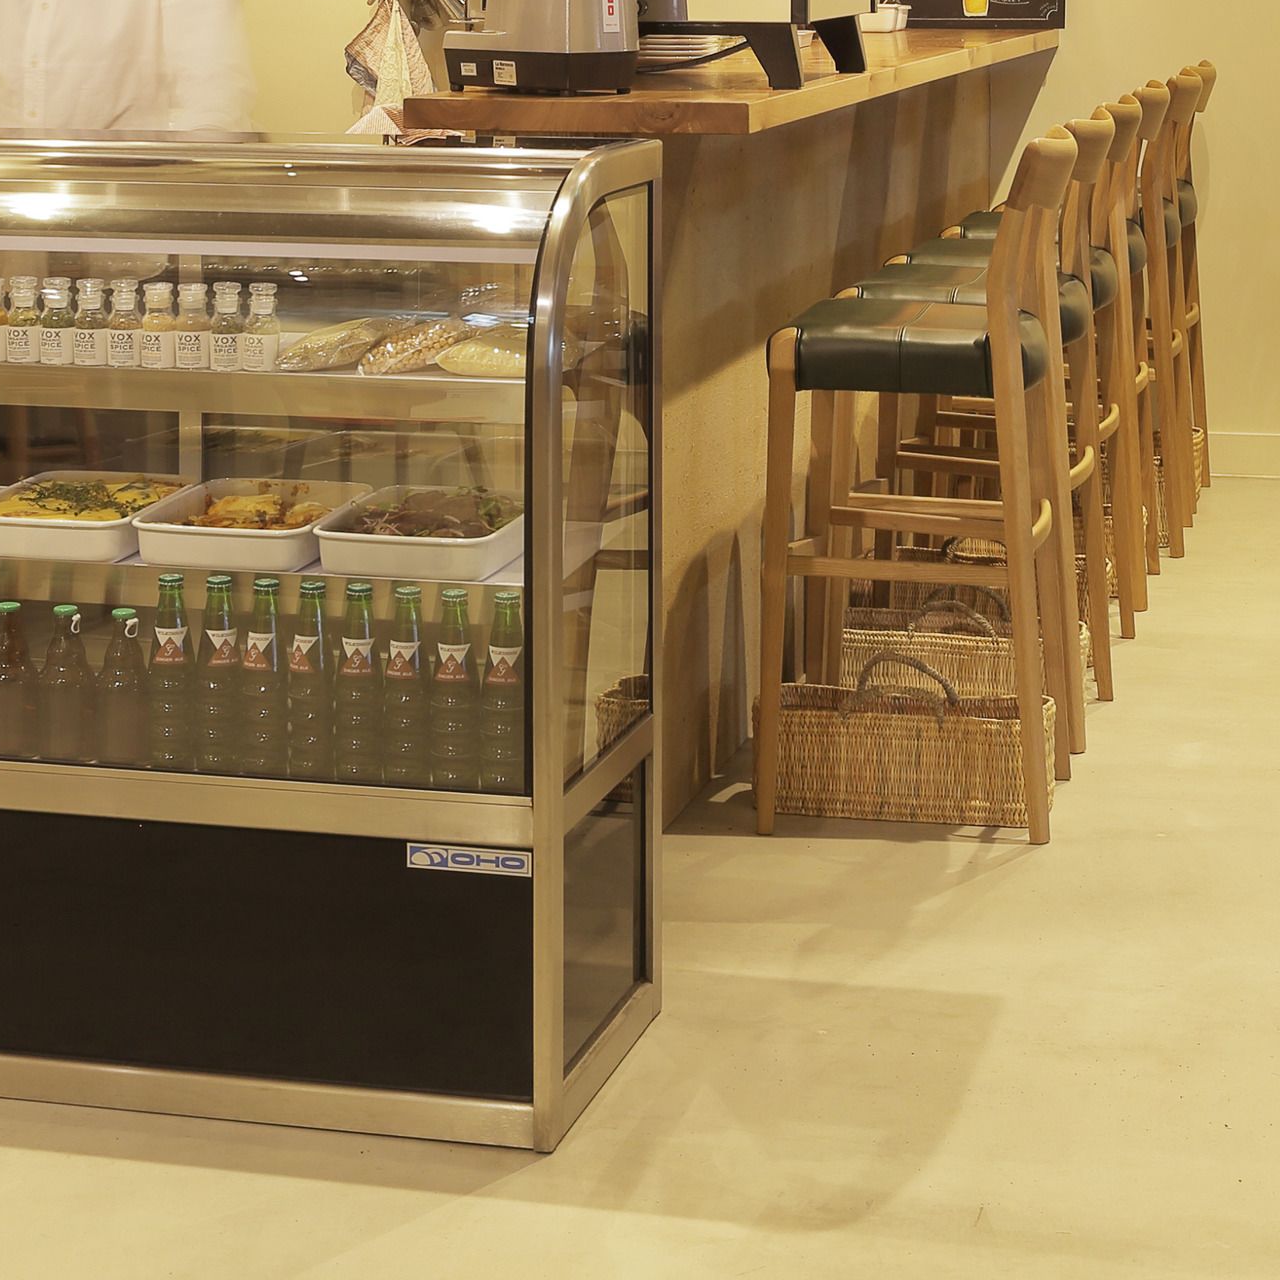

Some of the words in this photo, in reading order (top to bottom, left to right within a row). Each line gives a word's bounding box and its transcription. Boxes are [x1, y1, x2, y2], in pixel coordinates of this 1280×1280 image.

[110, 333, 134, 341] VOX
[177, 334, 201, 343] VOX
[213, 336, 237, 345] VOX
